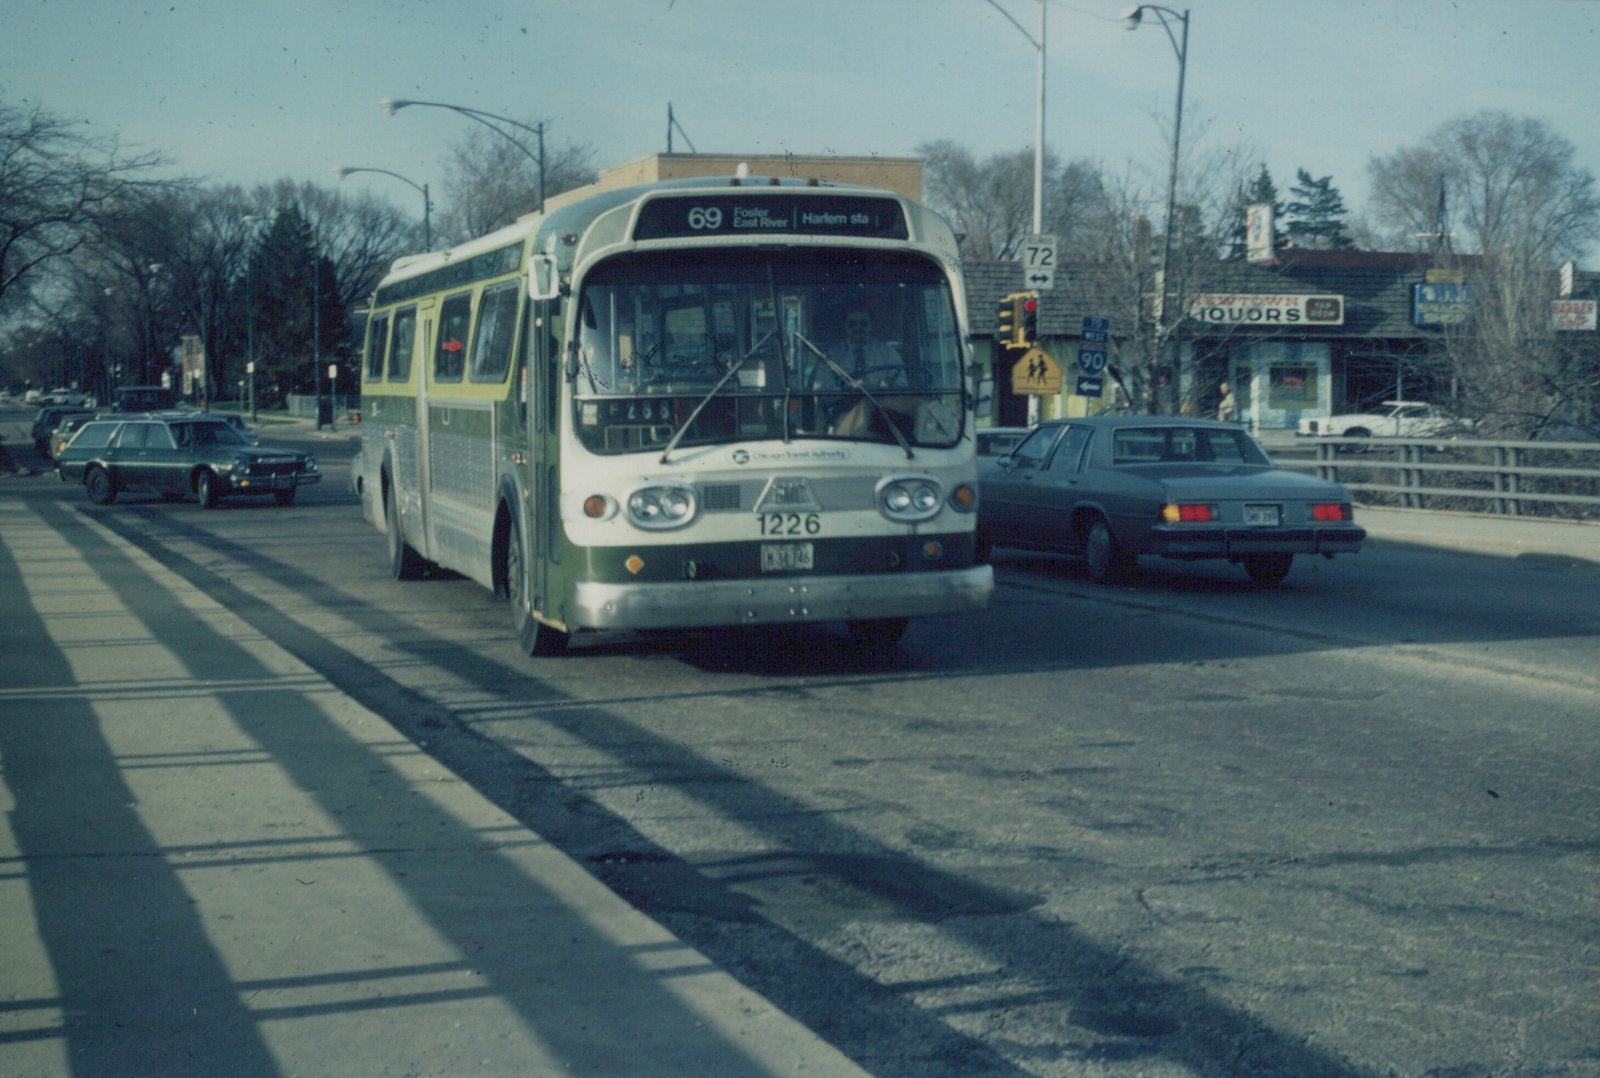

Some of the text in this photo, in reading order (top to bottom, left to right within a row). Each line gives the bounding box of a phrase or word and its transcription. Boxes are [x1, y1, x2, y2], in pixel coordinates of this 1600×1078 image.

[688, 207, 723, 229] 69
[733, 207, 769, 218] Foster
[802, 213, 869, 225] Harlem sta
[733, 217, 788, 229] East River
[1027, 247, 1053, 266] 72
[1085, 332, 1105, 342] WEST
[1081, 352, 1103, 369] 90
[756, 513, 821, 536] 1226
